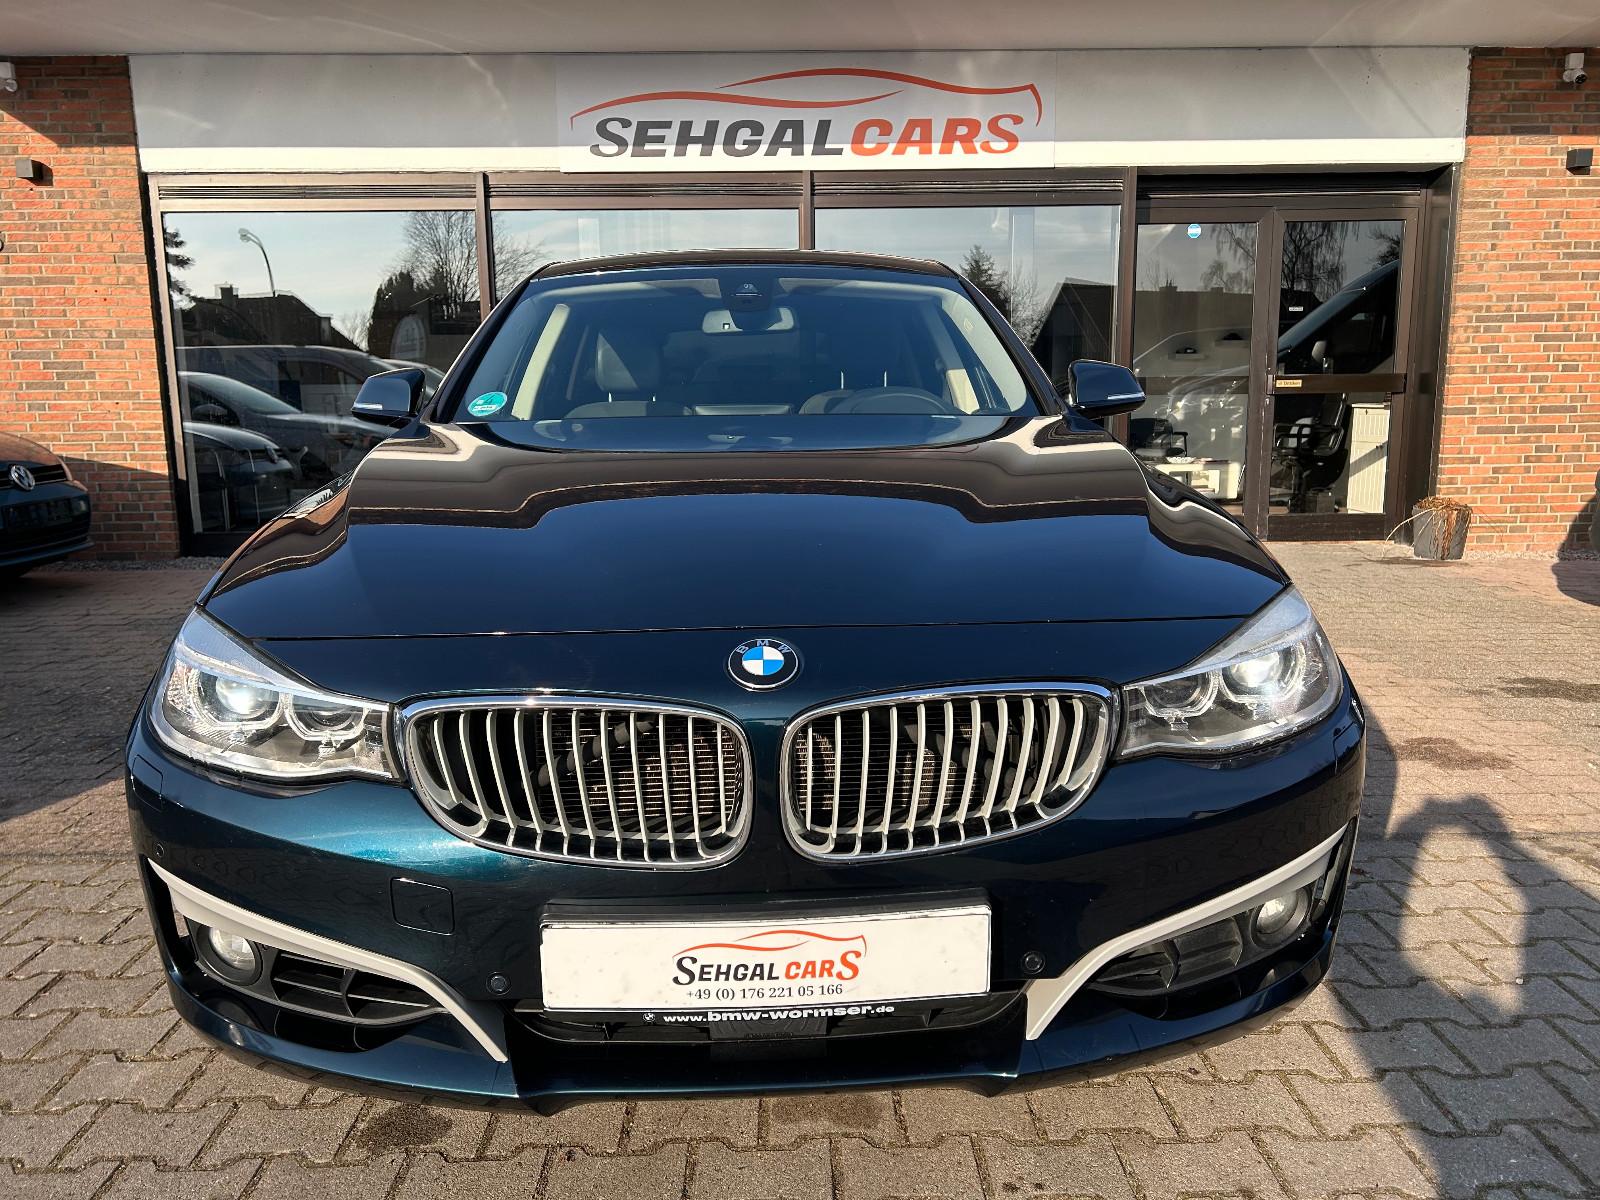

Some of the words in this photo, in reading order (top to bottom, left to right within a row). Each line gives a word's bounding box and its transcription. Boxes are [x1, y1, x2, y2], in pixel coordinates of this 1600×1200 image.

[735, 639, 792, 654] BMW
[672, 956, 780, 986] SEHGAL
[687, 988, 711, 1000] +49
[715, 987, 735, 1001] (0)
[740, 987, 765, 1000] 176
[768, 986, 793, 999] 221
[798, 985, 814, 997] 05
[818, 983, 843, 996] 166
[663, 1005, 895, 1022] www.bmw-wormser.de
